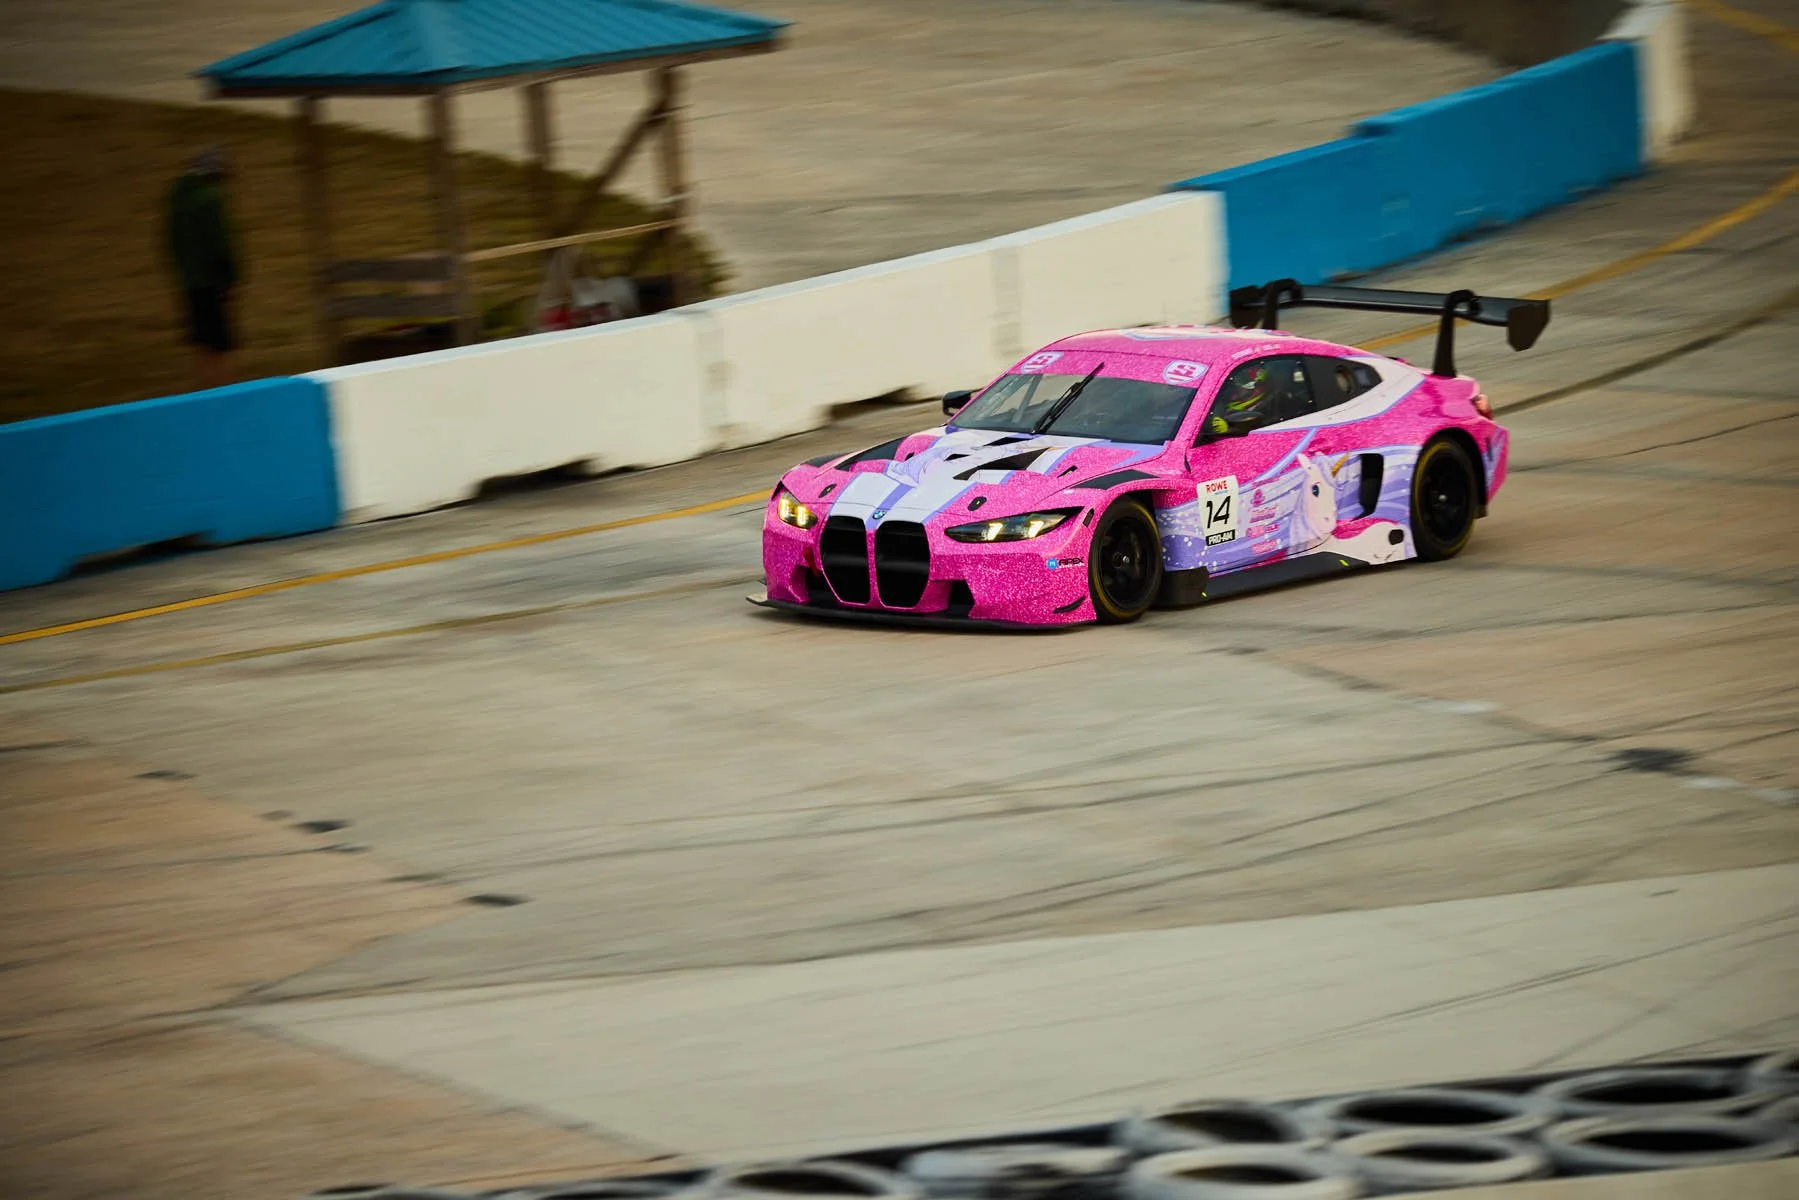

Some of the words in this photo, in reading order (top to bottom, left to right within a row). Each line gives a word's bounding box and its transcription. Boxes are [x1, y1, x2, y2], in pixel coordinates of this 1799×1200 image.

[1205, 480, 1228, 494] ROWE
[1206, 495, 1231, 529] 14
[1207, 530, 1233, 545] PRO-AM
